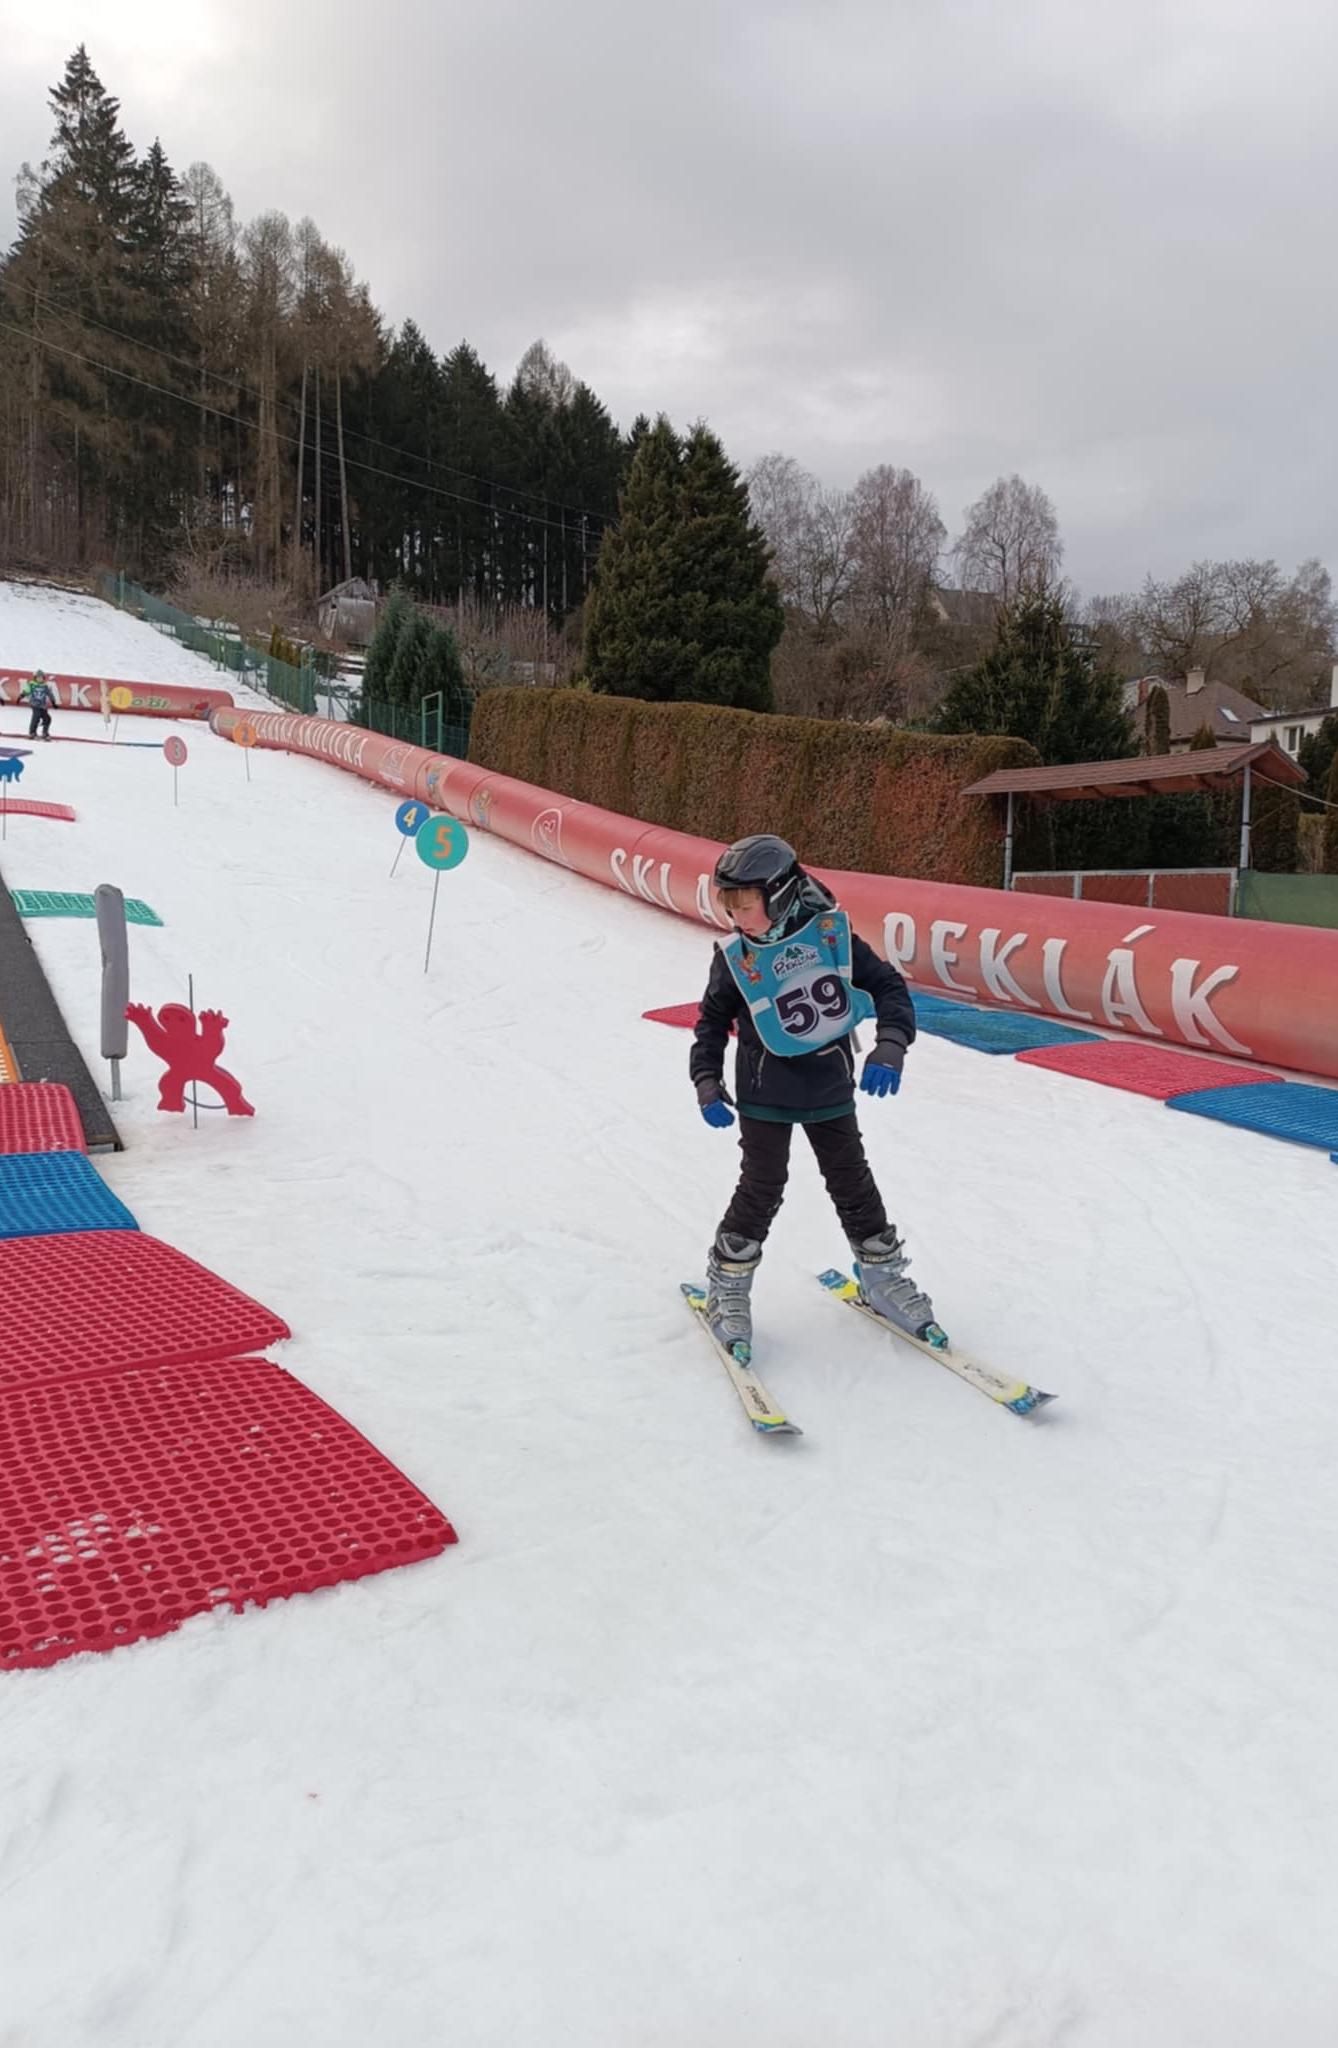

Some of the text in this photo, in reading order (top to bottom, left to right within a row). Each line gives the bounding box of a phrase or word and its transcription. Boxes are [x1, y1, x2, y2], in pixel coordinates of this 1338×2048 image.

[403, 807, 418, 829] 4
[433, 826, 453, 859] 5
[775, 974, 851, 1037] 59
[883, 912, 1253, 1055] PEKLÁK
